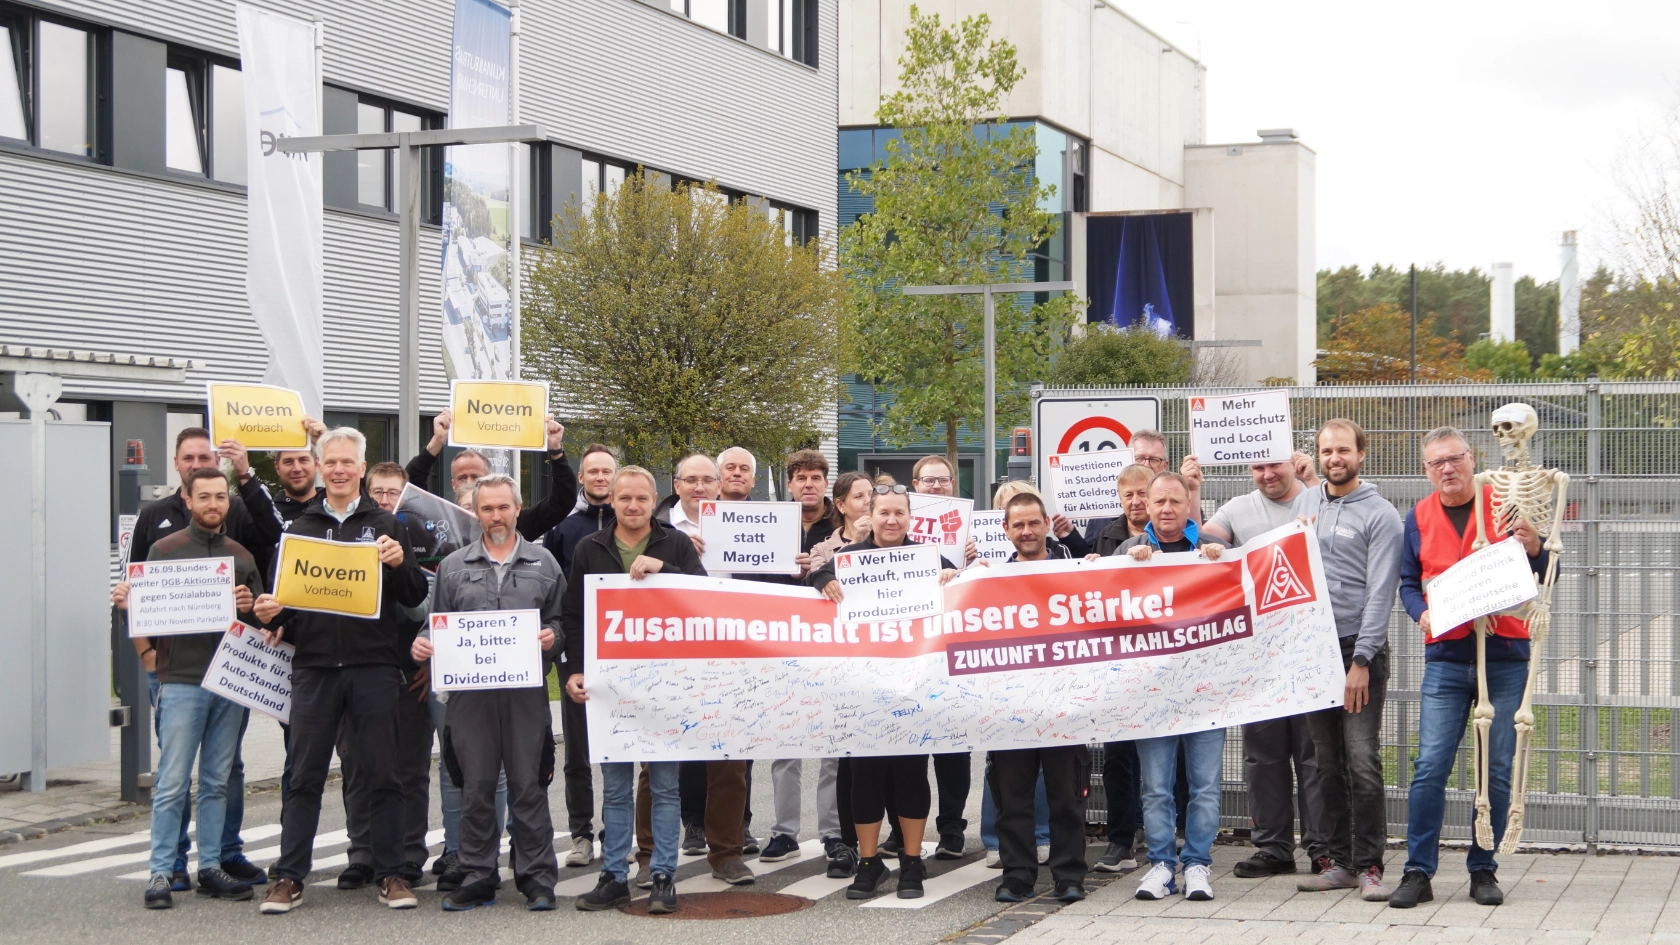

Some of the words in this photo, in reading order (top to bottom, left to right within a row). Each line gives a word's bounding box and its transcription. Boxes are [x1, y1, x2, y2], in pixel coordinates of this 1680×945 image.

[226, 401, 293, 417] Novem
[467, 399, 532, 416] Novem
[1222, 398, 1256, 410] Mehr
[239, 422, 284, 433] Vorbach
[477, 421, 521, 432] Vorbach
[1193, 414, 1286, 428] Handelsschutz
[1210, 433, 1235, 445] und
[1239, 430, 1272, 443] Local
[1213, 448, 1271, 461] Content!
[1061, 460, 1123, 472] Investitionen
[1064, 476, 1074, 485] in
[1057, 489, 1077, 499] statt
[1079, 486, 1120, 499] Geldreg
[1063, 503, 1078, 512] für
[722, 511, 778, 523] Mensch
[971, 517, 1005, 529] pare
[733, 533, 766, 543] statt
[985, 531, 1012, 542] bitt
[723, 551, 775, 566] Marge!
[858, 554, 886, 566] Wer
[889, 550, 916, 563] hier
[294, 558, 366, 582] Novem
[1433, 548, 1500, 588] Unternehmen
[1458, 569, 1478, 584] und
[1480, 555, 1515, 573] Politik
[131, 579, 159, 588] weiter
[161, 576, 231, 588] DGB-Aktionstag
[840, 569, 900, 586] verkauft,
[903, 568, 938, 580] muss
[140, 594, 167, 603] gegen
[169, 590, 222, 600] Sozialabbau
[304, 584, 353, 598] Vorbach
[877, 588, 904, 600] hier
[1443, 578, 1492, 605] Ruinieren
[1468, 581, 1519, 604] deutsche
[140, 605, 167, 614] Abfahrt
[168, 605, 186, 613] nach
[187, 602, 222, 612] Nürnberg
[604, 610, 860, 645] Zusammenhalt
[922, 603, 1039, 639] unsere
[1047, 585, 1175, 627] Stärke!
[848, 600, 935, 621] produzieren!
[1445, 594, 1523, 629] Auto-Industrie
[136, 619, 152, 628] 8:30
[154, 617, 168, 626] Uhr
[169, 616, 195, 625] Novem
[196, 615, 230, 625] Parkplatz
[458, 617, 506, 632] Sparen
[510, 615, 518, 627] ?
[456, 636, 476, 648] Ja,
[480, 634, 517, 647] bitte:
[953, 641, 1047, 671] ZUKUNFT
[1051, 633, 1114, 661] STATT
[1119, 614, 1248, 654] KAHLSCHLAG
[222, 642, 268, 670] Produkte
[269, 663, 286, 678] für
[475, 652, 497, 665] bei
[443, 670, 529, 686] Dividenden!
[218, 676, 286, 712] Deutschland
